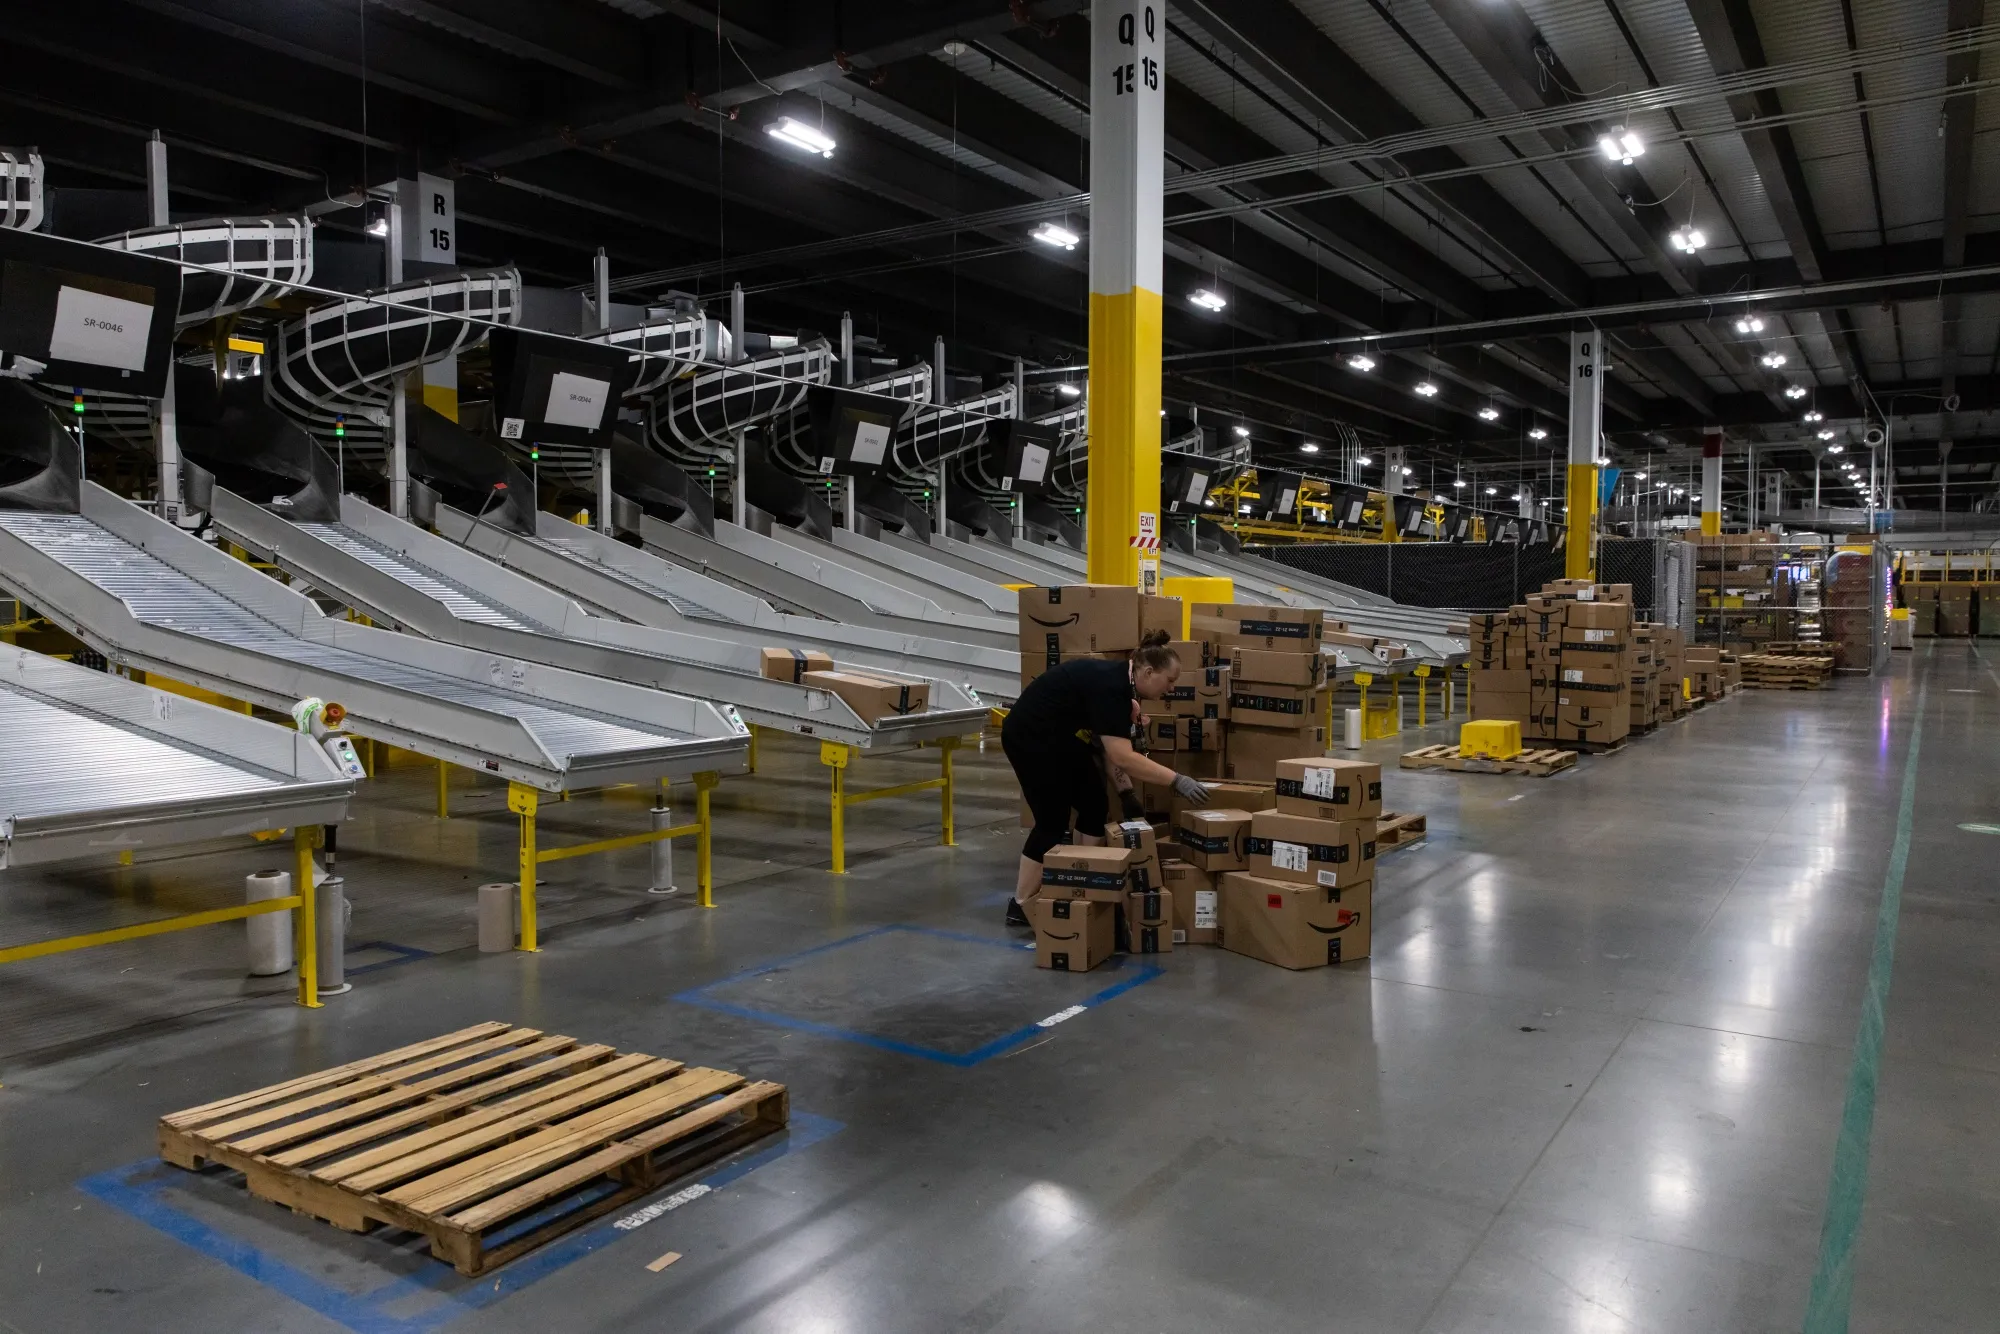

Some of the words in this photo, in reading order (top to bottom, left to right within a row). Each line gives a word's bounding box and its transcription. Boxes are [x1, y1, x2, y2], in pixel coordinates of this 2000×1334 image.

[1118, 13, 1135, 47] Q
[1145, 6, 1155, 43] Q
[1112, 63, 1134, 96] 15
[1142, 56, 1158, 91] 15
[433, 193, 446, 216] R
[430, 228, 450, 251] 15
[83, 317, 124, 333] SR-0046
[1581, 342, 1591, 357] Q
[1577, 364, 1593, 378] 16
[1390, 465, 1399, 473] 17
[1140, 515, 1155, 527] EXIT
